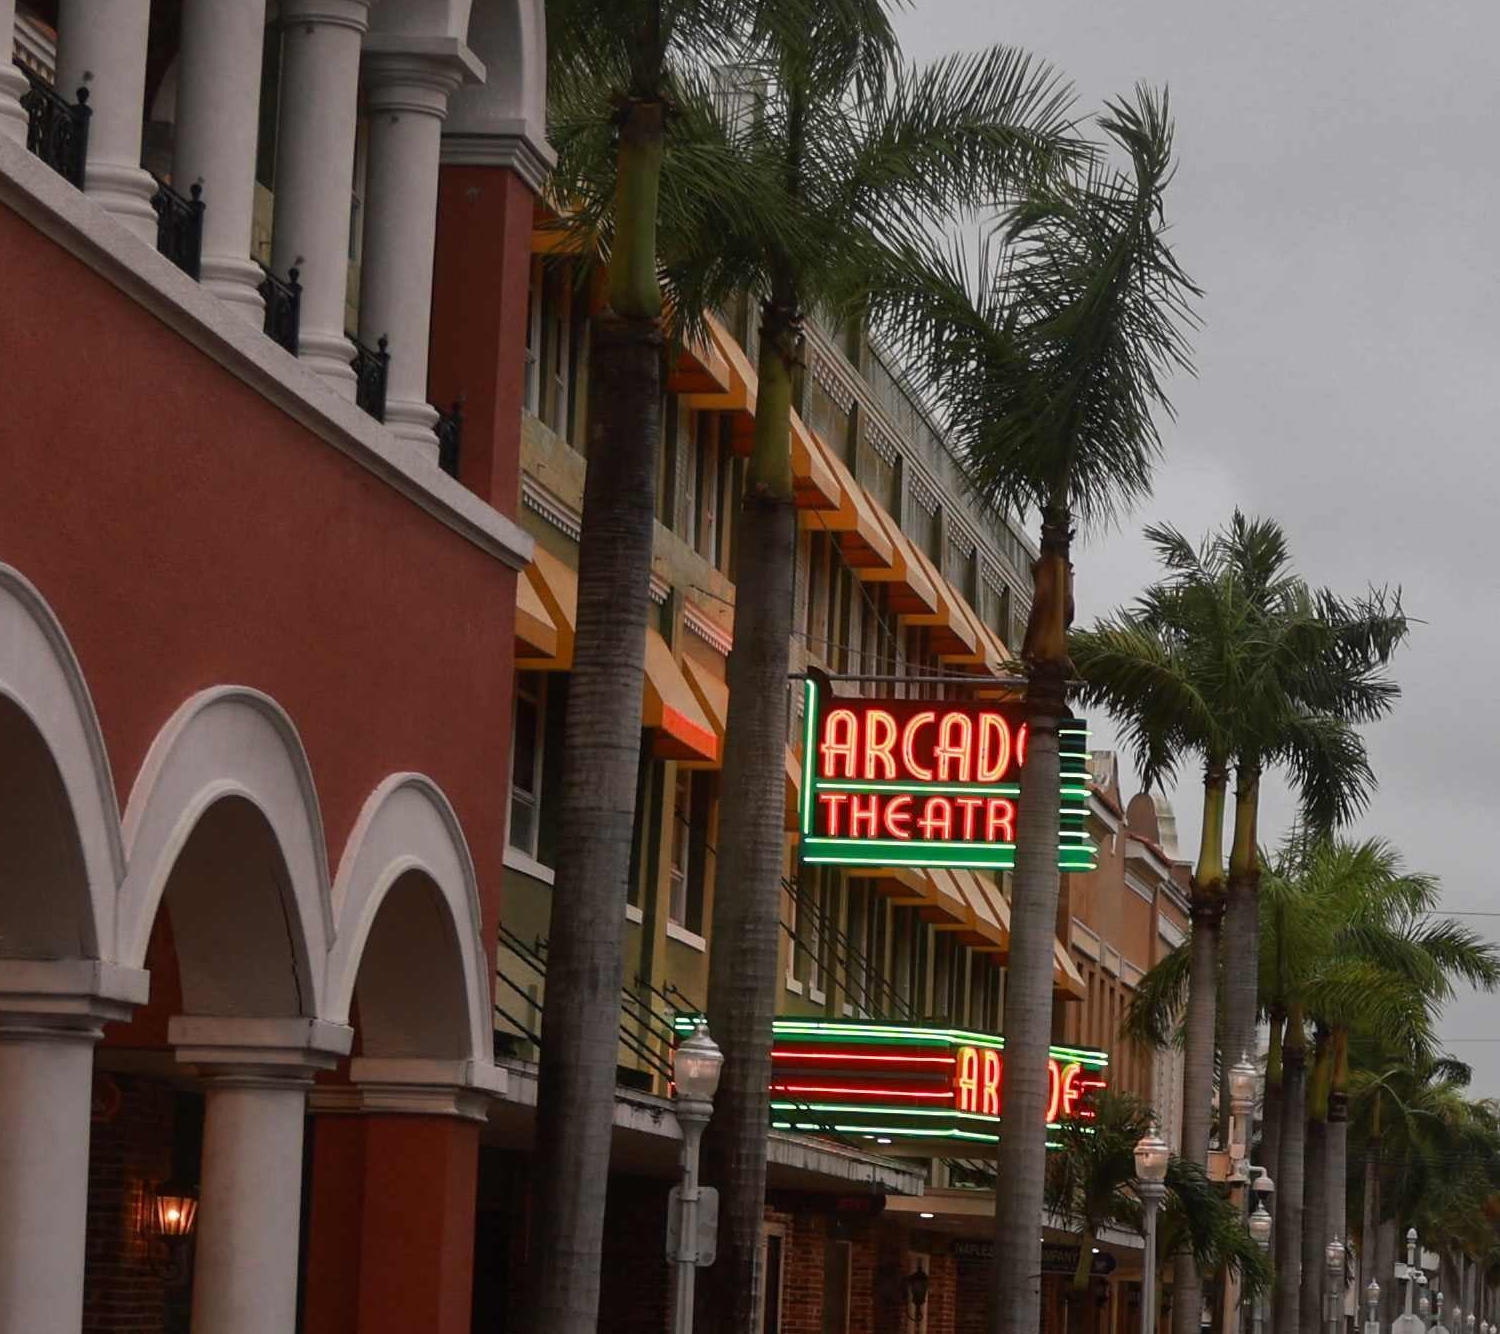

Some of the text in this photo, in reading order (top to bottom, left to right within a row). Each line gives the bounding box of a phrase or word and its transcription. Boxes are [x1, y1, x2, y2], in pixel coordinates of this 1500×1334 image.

[818, 794, 1016, 842] THEATR
[955, 1046, 1083, 1123] ARDE
[1043, 1249, 1080, 1261] MPANY
